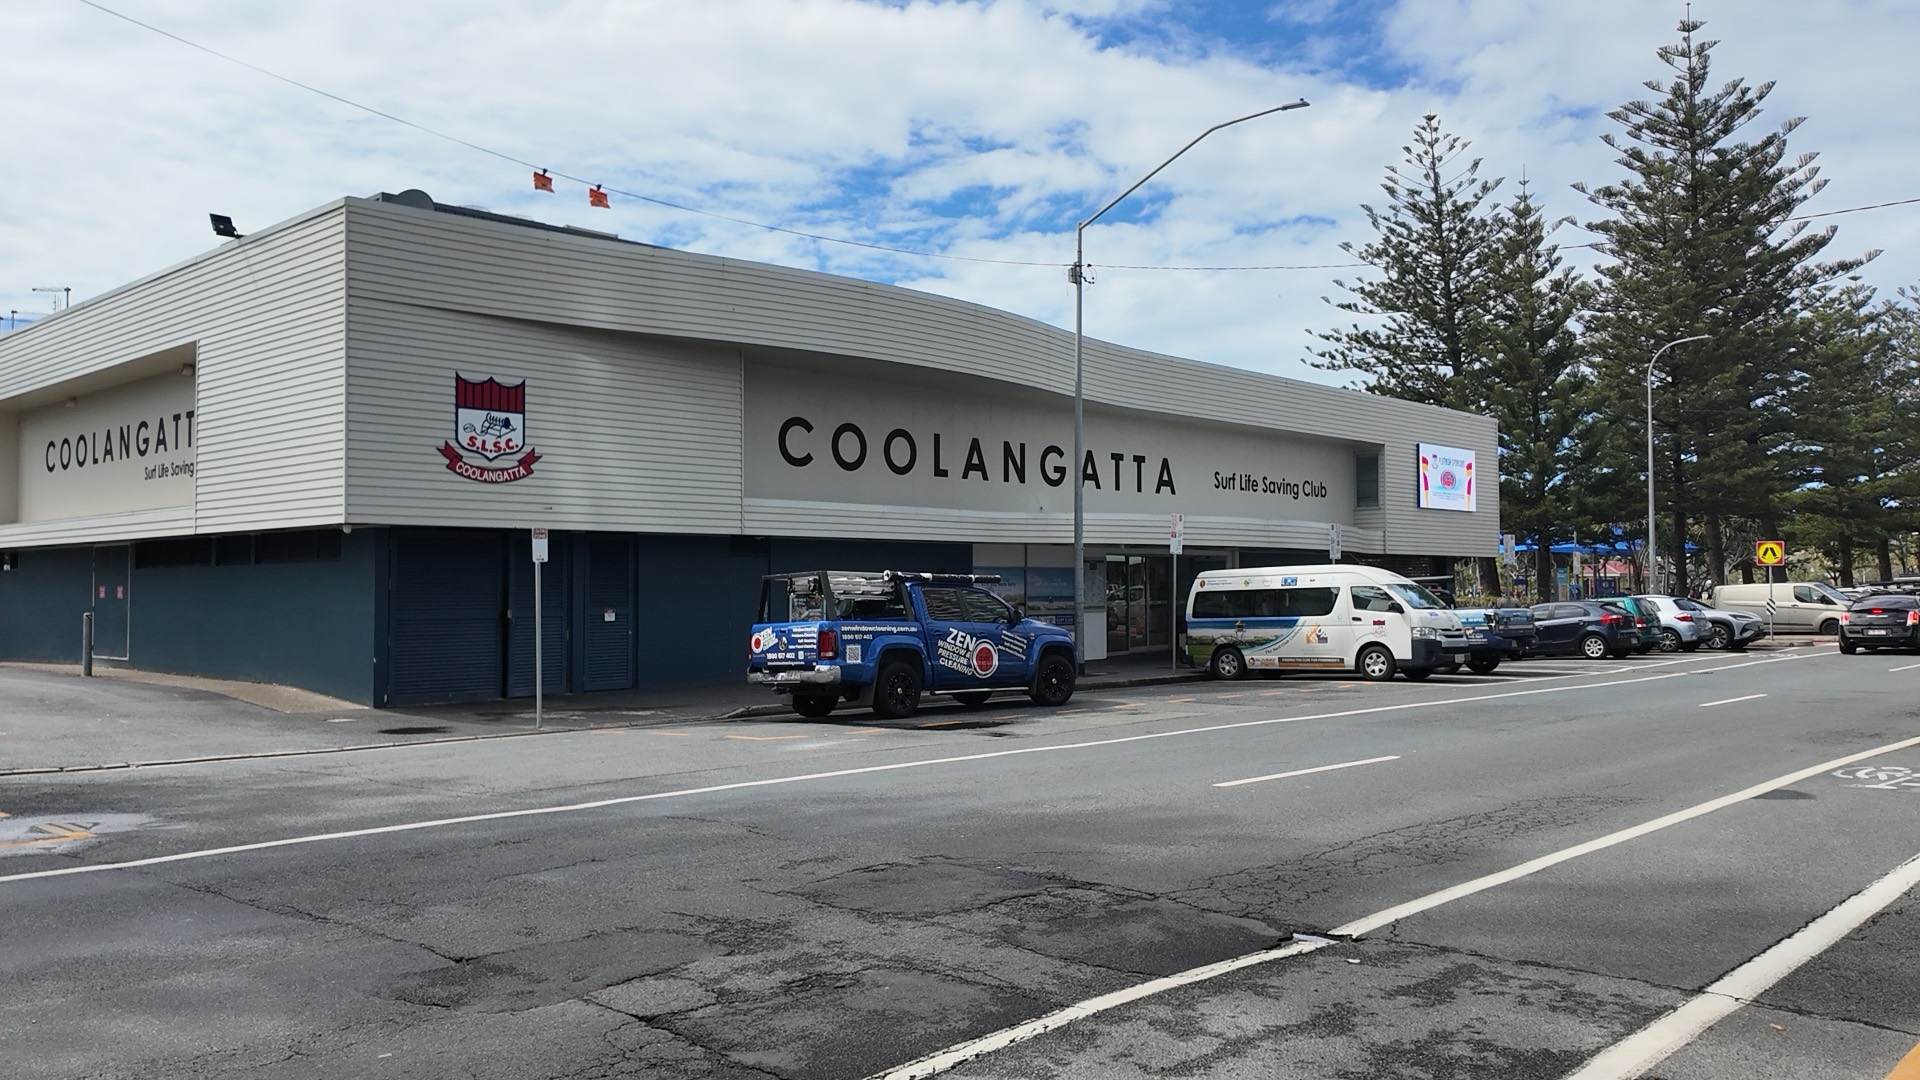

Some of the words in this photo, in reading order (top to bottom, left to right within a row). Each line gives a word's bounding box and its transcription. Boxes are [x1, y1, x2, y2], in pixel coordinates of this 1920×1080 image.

[45, 410, 195, 472] COOLANGATT
[467, 435, 520, 453] S.L.S.C.
[778, 416, 1177, 496] COOLANGATTA
[144, 466, 157, 481] Surf
[157, 463, 170, 479] Life
[170, 459, 195, 478] Saving
[455, 462, 527, 482] COOLANGATTA
[1214, 470, 1238, 492] Surf
[1239, 473, 1260, 493] Life
[1261, 476, 1299, 500] Saving
[1302, 478, 1328, 498] Club
[841, 625, 918, 633] zenwindowcleaning.com.au
[946, 627, 977, 651] ZEN
[937, 639, 967, 656] WINDOW
[966, 651, 972, 659] &
[937, 648, 968, 666] PRESSURE
[939, 657, 975, 676] CLEANING
